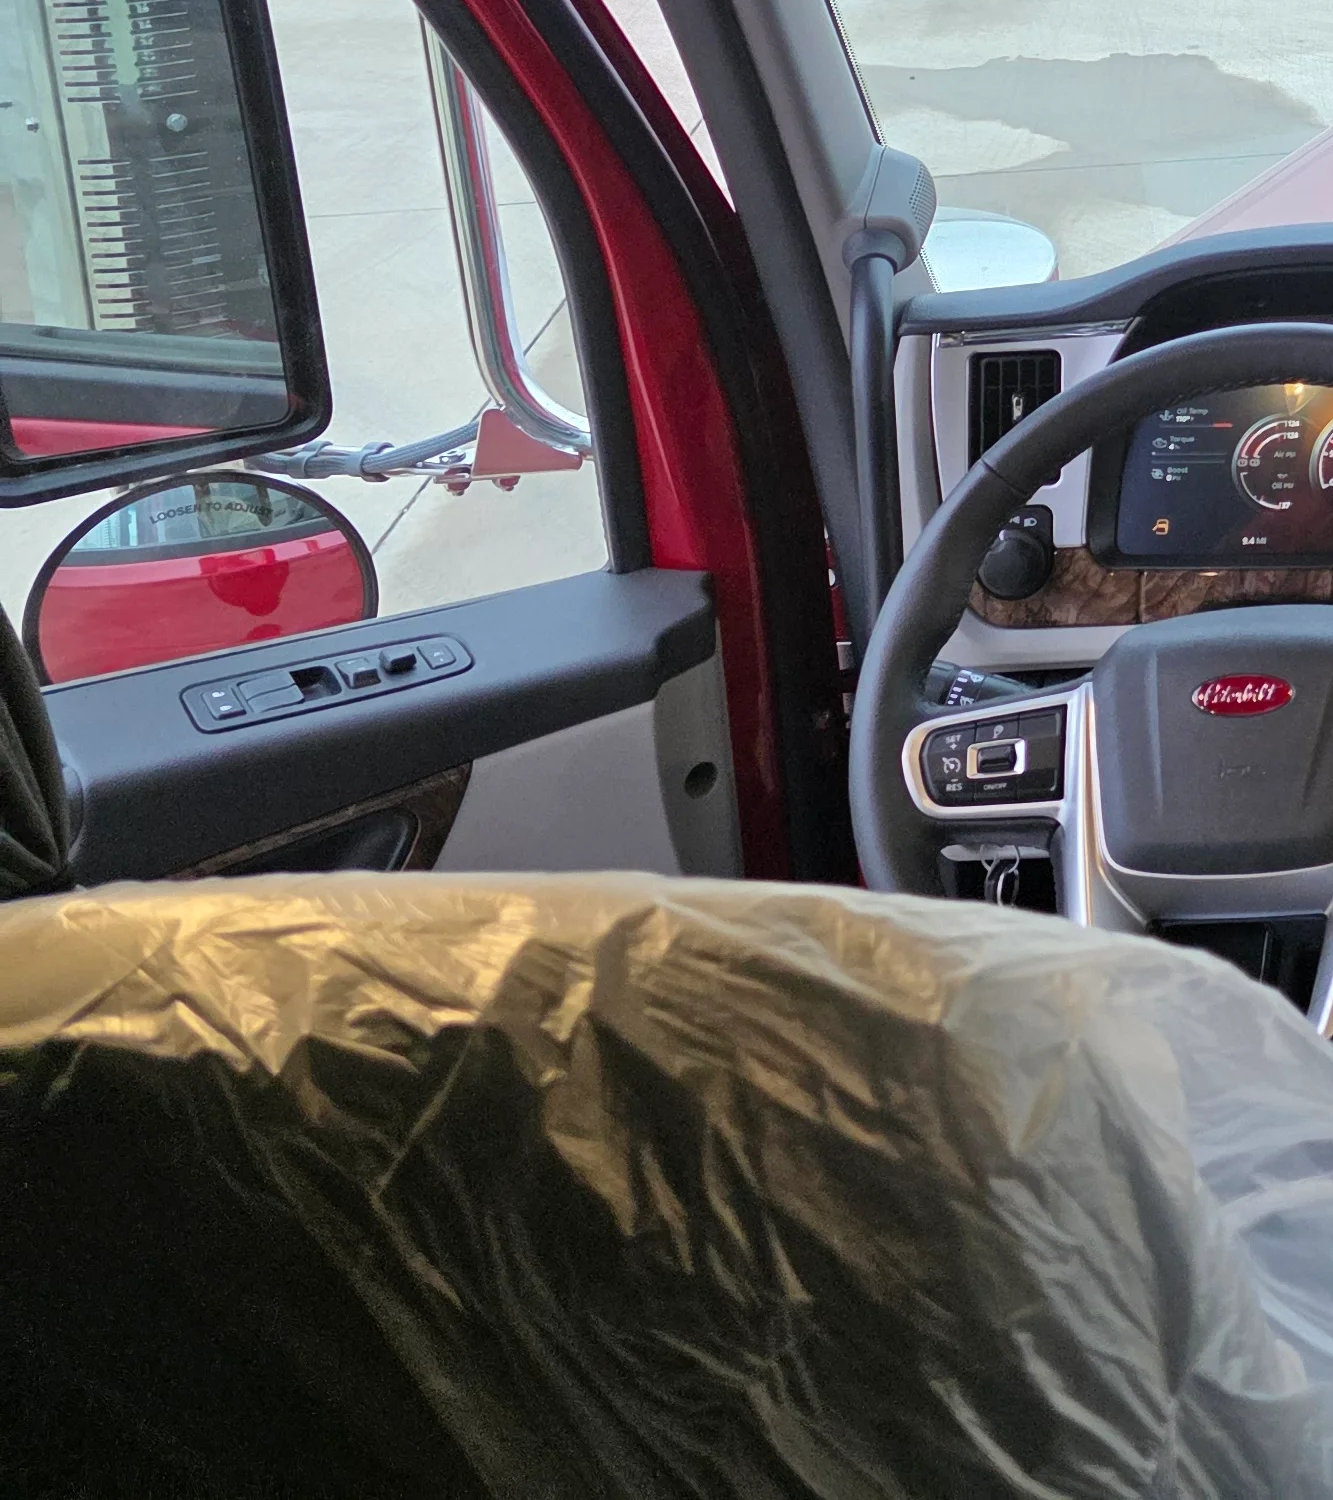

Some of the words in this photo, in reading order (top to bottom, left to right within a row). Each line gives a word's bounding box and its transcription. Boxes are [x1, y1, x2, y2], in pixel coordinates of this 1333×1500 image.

[206, 501, 223, 512] TO
[945, 734, 961, 744] SET
[945, 782, 963, 792] RES
